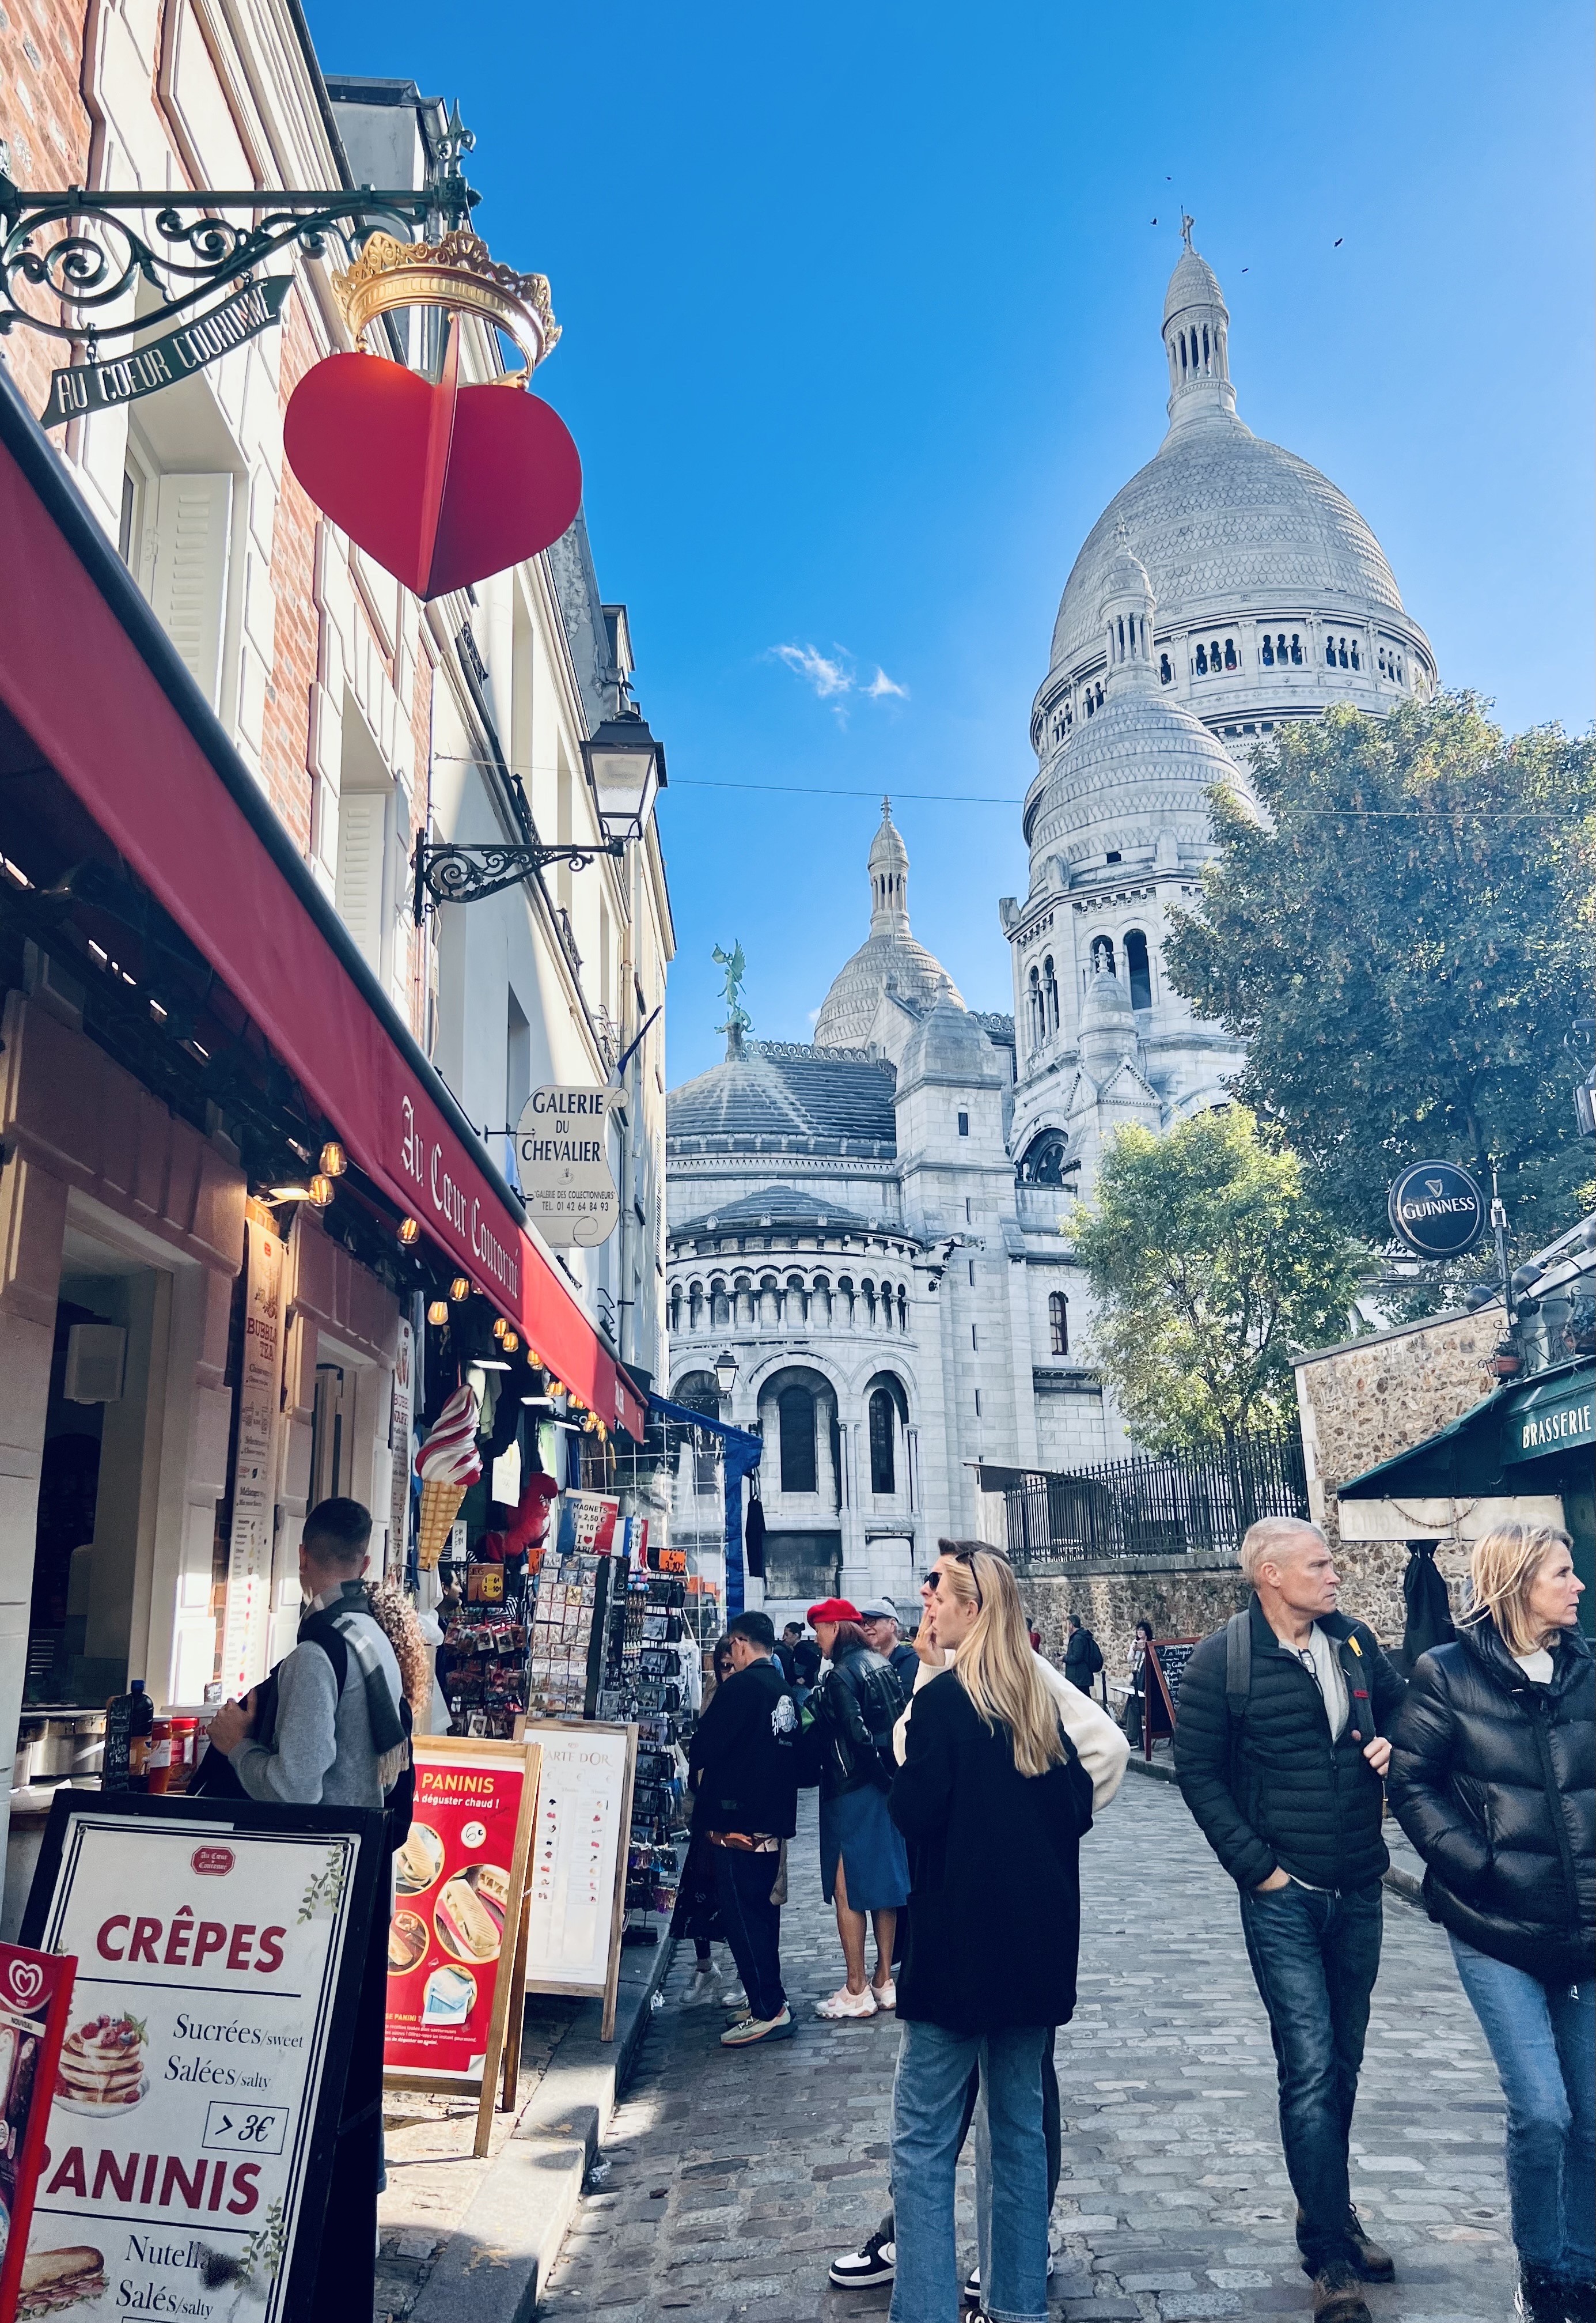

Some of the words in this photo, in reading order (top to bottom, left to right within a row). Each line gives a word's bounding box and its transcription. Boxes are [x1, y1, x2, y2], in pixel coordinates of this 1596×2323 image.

[56, 372, 88, 414] AU
[97, 349, 173, 402] COEUR
[533, 1092, 604, 1114] GALERIE
[556, 1120, 569, 1133] DU
[401, 1095, 424, 1187] Au
[522, 1140, 601, 1162] CHEVALIER
[557, 1201, 563, 1210] 01
[567, 1202, 575, 1210] 42
[578, 1202, 586, 1210] 64
[589, 1202, 597, 1210] 84
[601, 1202, 608, 1211] 93
[1402, 1197, 1475, 1219] GUINNESS
[1523, 1405, 1591, 1448] BRASSERIE
[573, 1503, 608, 1514] MAGNETS
[580, 1752, 613, 1767] D'OR
[422, 1773, 494, 1794] PANINIS
[422, 1794, 464, 1806] déguster
[465, 1797, 494, 1809] chaud
[495, 1799, 499, 1809] !
[97, 1905, 287, 1973] CRÊPES
[238, 2114, 275, 2142] 3€
[124, 2234, 211, 2270] Nutell
